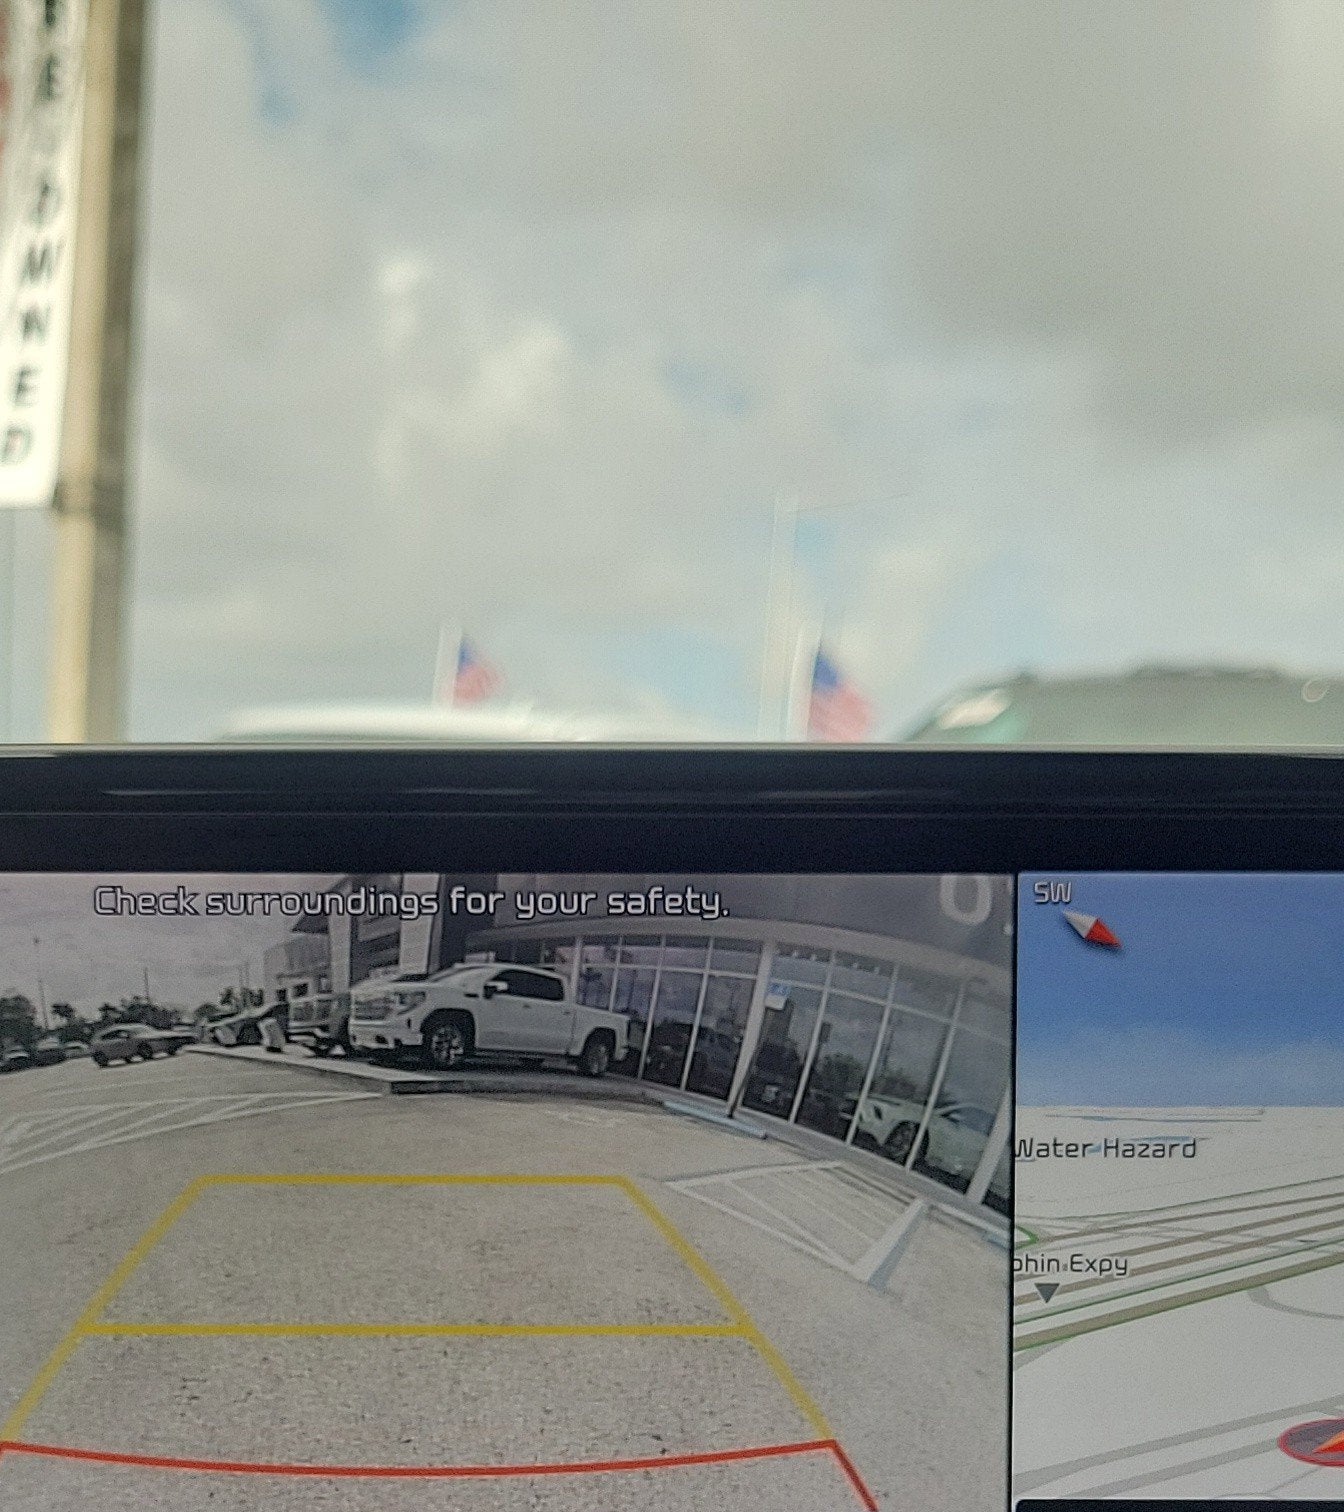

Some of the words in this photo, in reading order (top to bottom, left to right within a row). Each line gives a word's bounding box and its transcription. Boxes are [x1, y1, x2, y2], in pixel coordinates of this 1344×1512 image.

[94, 886, 200, 916] Check
[206, 886, 440, 920] surroundings
[450, 886, 504, 916] for
[516, 890, 597, 920] your
[608, 886, 731, 920] safety.
[1033, 881, 1073, 904] SW
[1014, 1137, 1095, 1159] Water
[1103, 1137, 1197, 1159] Hazard
[1070, 1253, 1129, 1277] Expy
